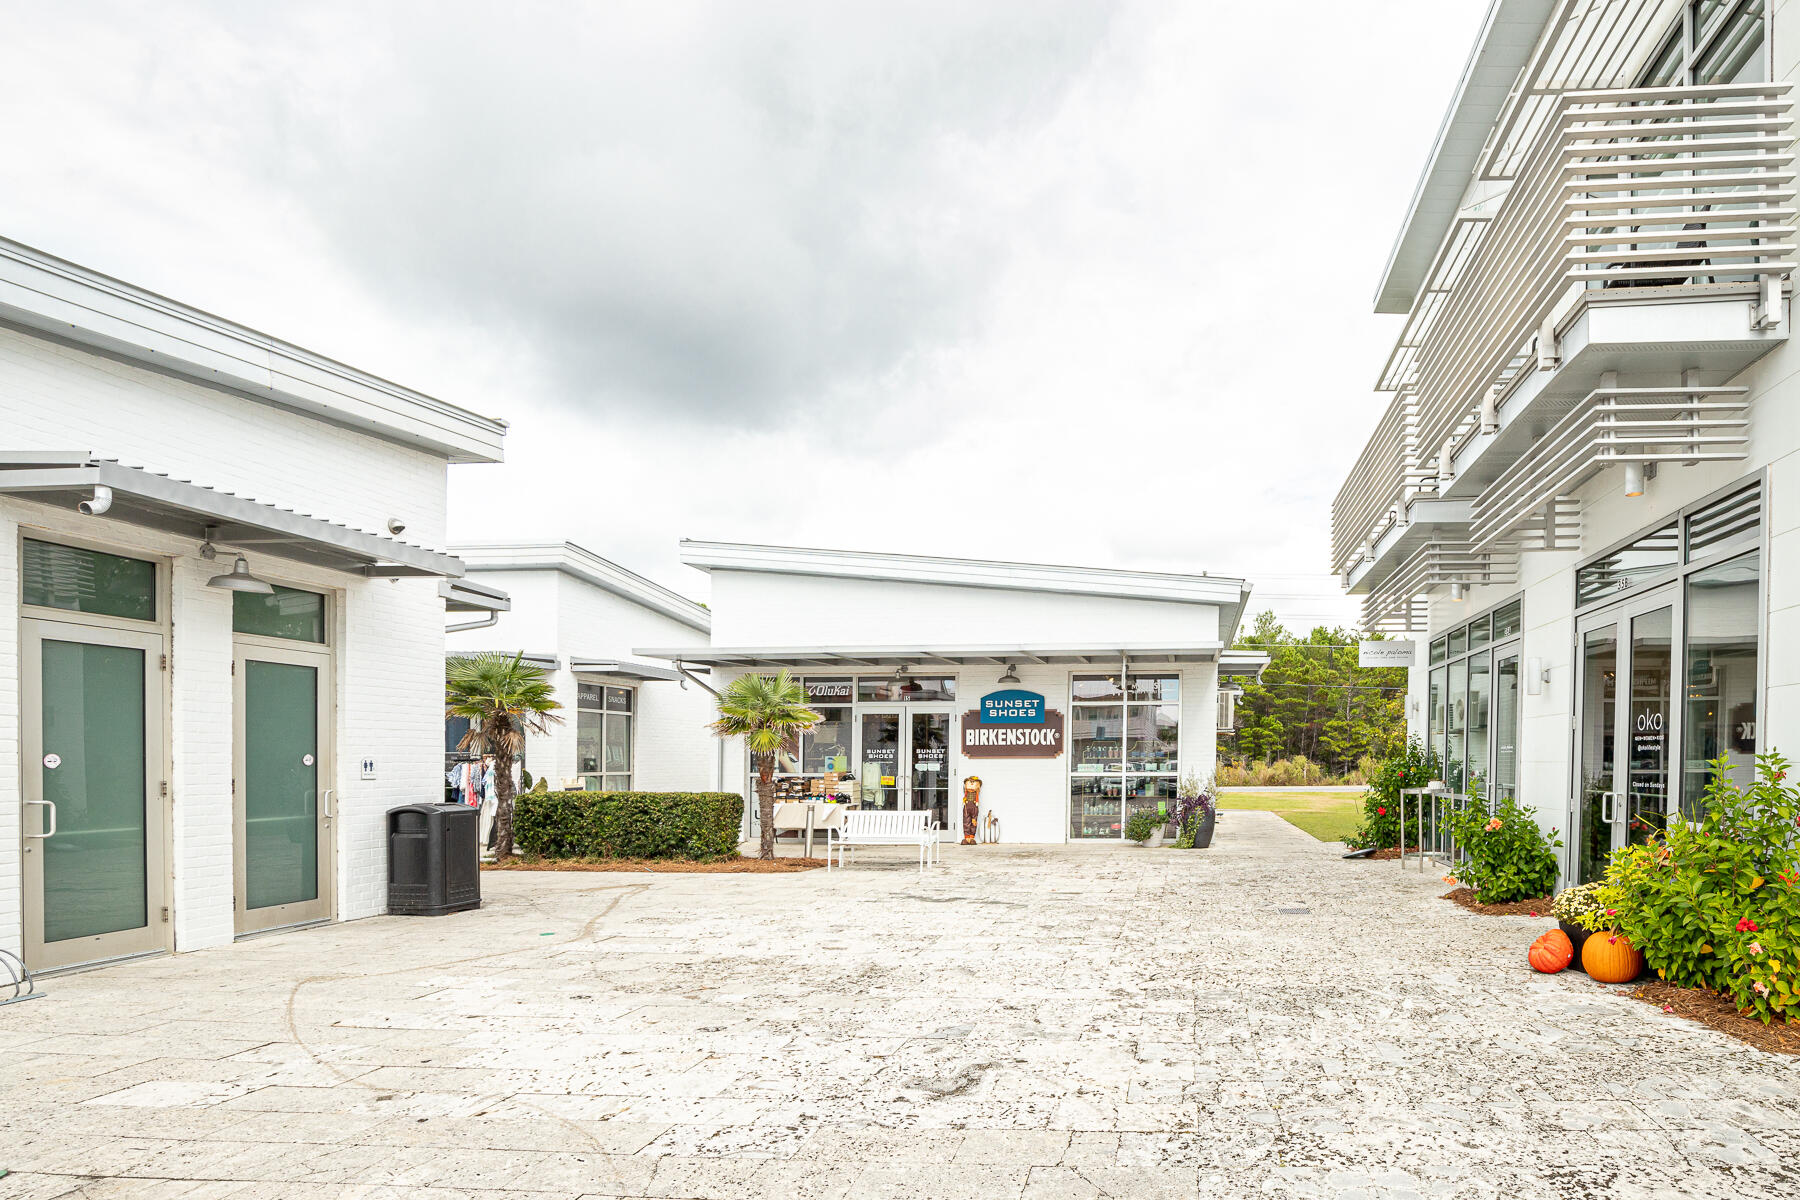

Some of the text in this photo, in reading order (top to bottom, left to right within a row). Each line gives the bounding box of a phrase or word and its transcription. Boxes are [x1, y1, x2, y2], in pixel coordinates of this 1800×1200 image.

[816, 685, 850, 696] OluKai
[608, 696, 626, 705] SNACKS
[985, 699, 1040, 708] SUNSET
[989, 709, 1036, 717] SHOES
[1637, 707, 1663, 731] oko
[966, 728, 1056, 746] BIRKENSTOCK
